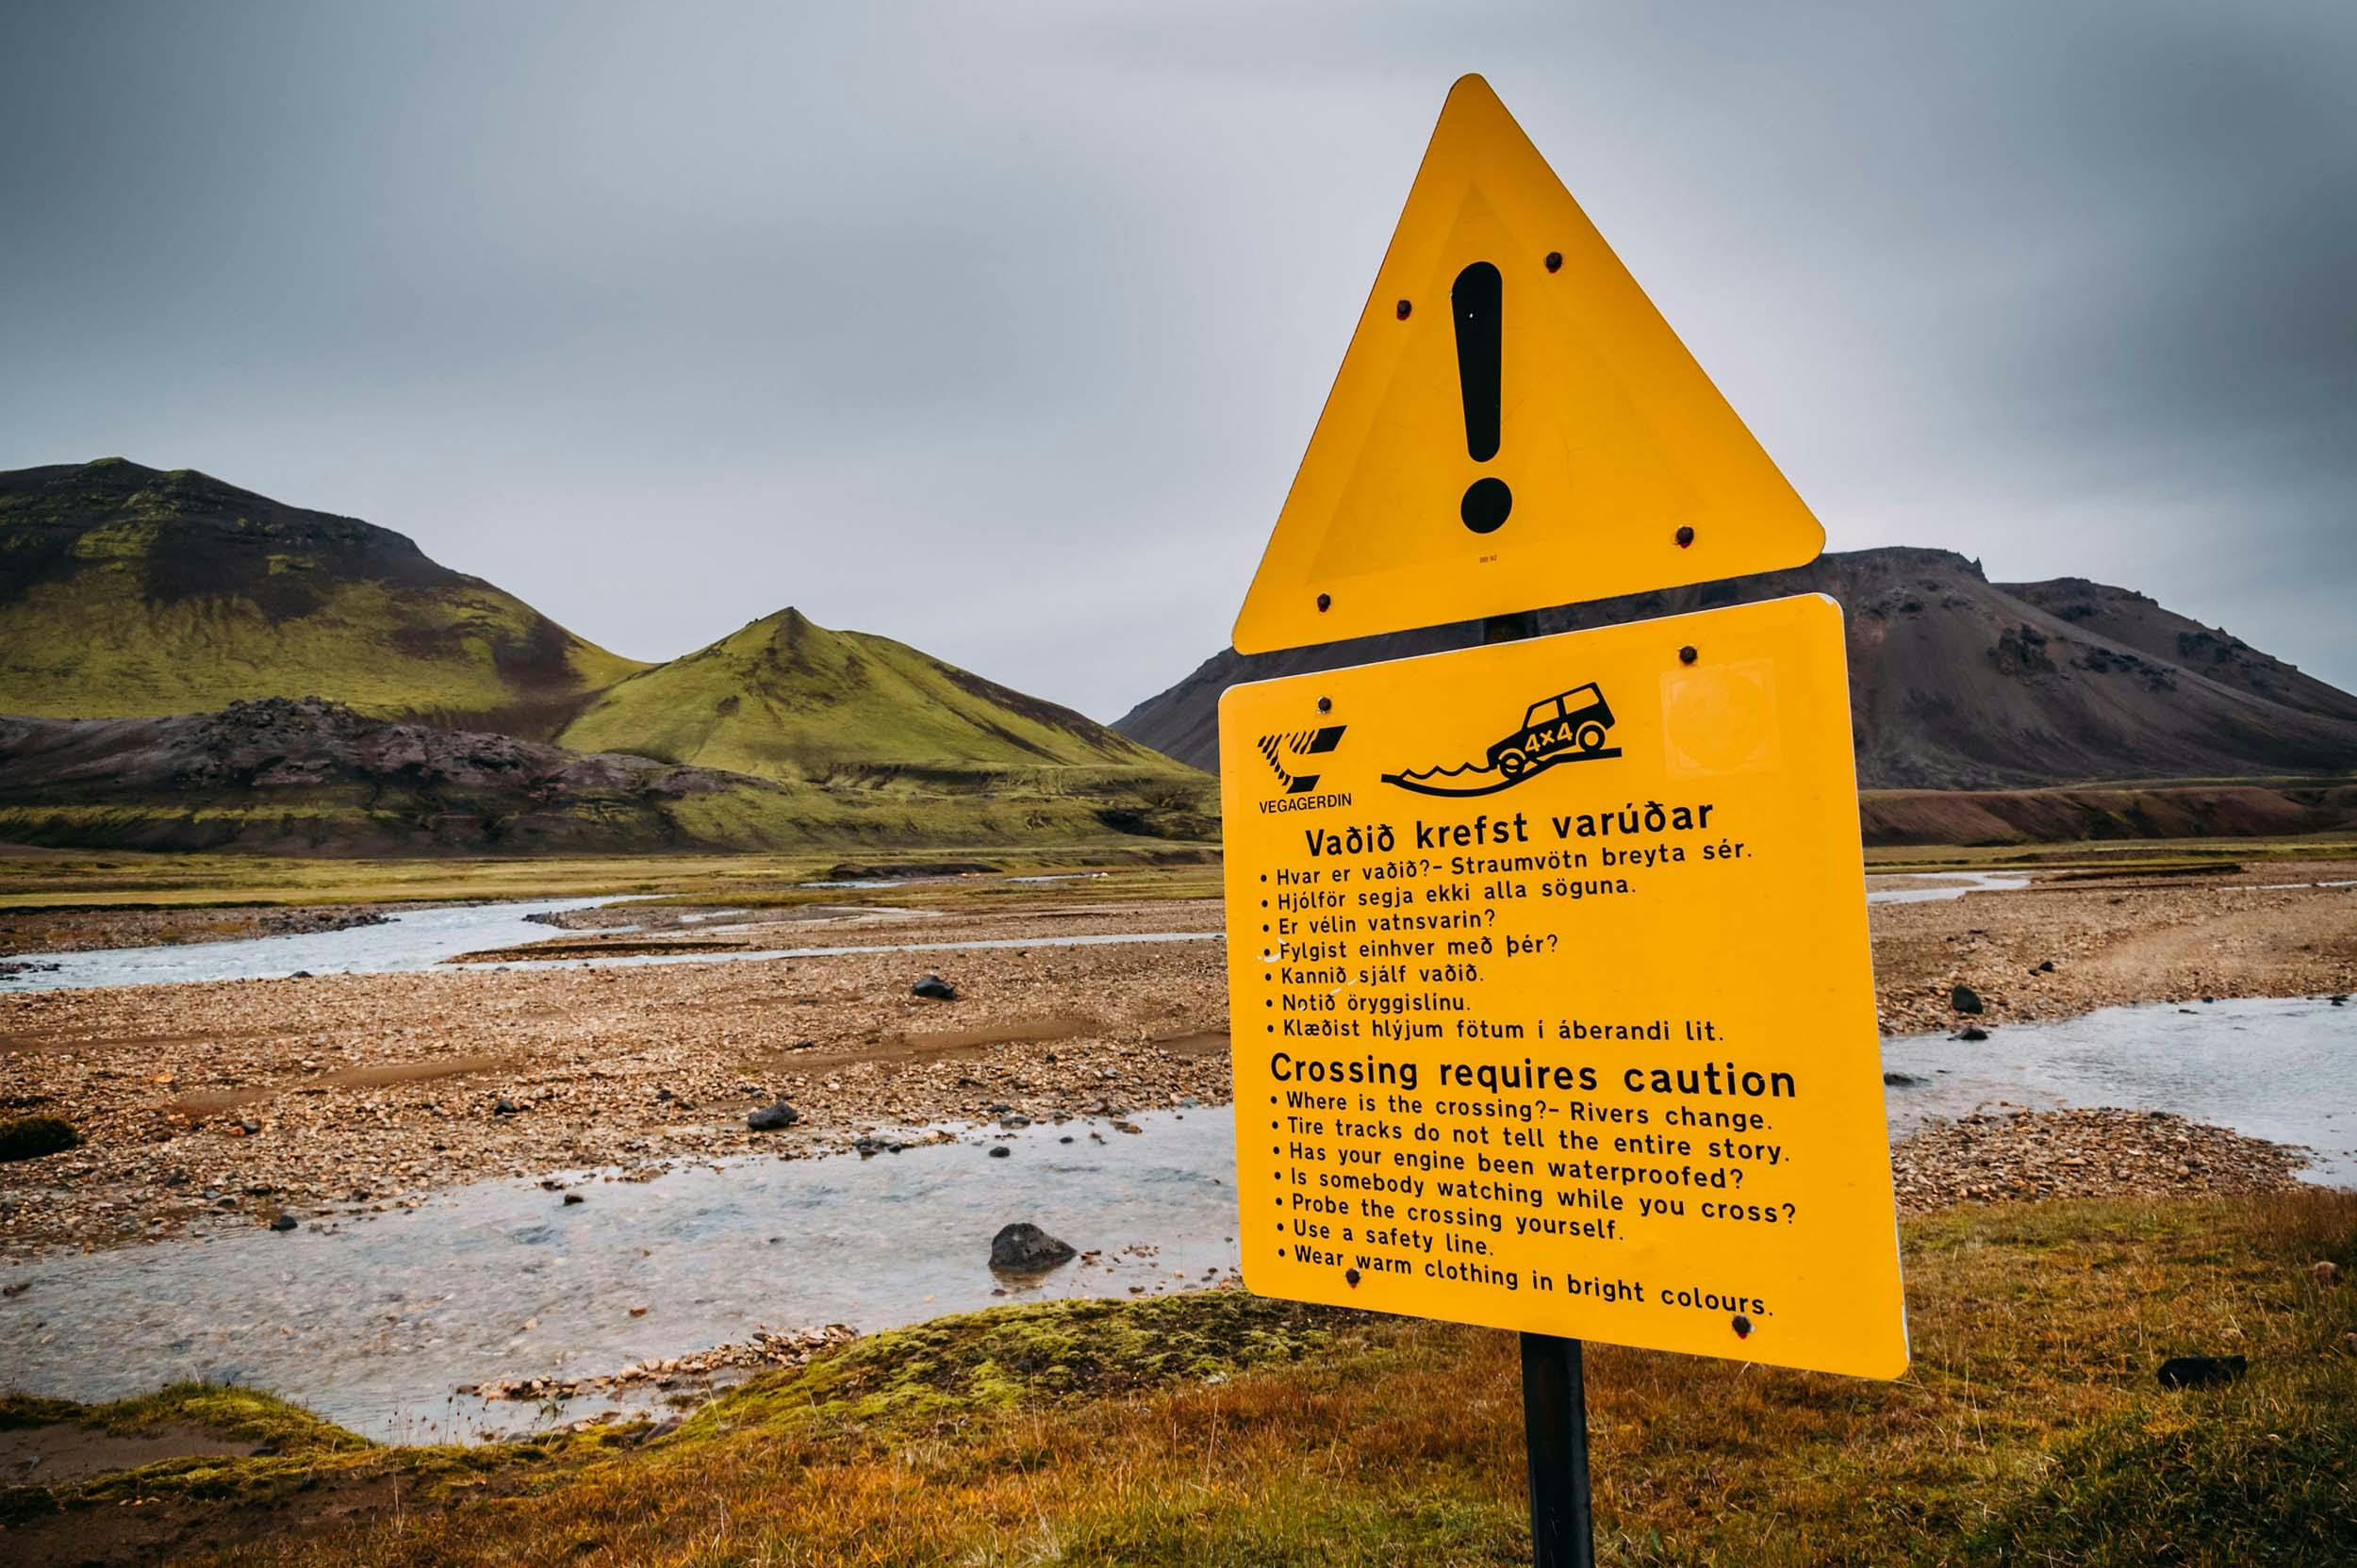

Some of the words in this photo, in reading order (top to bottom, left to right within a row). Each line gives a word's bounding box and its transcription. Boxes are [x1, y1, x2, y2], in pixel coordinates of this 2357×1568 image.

[1525, 721, 1574, 752] 4x4
[1305, 823, 1395, 857] Vaðið
[1416, 812, 1529, 850] krefst
[1551, 801, 1714, 839] varúðar
[1277, 868, 1321, 886] Hvar
[1331, 868, 1351, 883] er
[1451, 850, 1588, 875] Straumvötn
[1602, 843, 1686, 868] breyta
[1703, 838, 1752, 861] sér.
[1277, 890, 1346, 914] Hjólför
[1358, 886, 1413, 909] segja
[1426, 883, 1470, 902] ekki
[1484, 880, 1527, 900] alla
[1541, 879, 1636, 900] söguna.
[1278, 917, 1298, 935] Er
[1309, 916, 1357, 933] vélin
[1367, 908, 1495, 932] vatnsvarin?
[1279, 940, 1347, 963] Fylgist
[1359, 938, 1435, 958] einhver
[1447, 935, 1493, 955] með
[1506, 933, 1558, 958] þér?
[1281, 966, 1347, 984] Kannið
[1360, 965, 1407, 987] sjálf
[1419, 963, 1486, 982] vaðið.
[1282, 993, 1336, 1012] Notið
[1347, 992, 1472, 1015] öryggislínu.
[1283, 1018, 1360, 1037] Klæðist
[1372, 1018, 1443, 1042] hlýjum
[1456, 1019, 1525, 1039] fötum
[1558, 1019, 1670, 1041] áberandi
[1686, 1020, 1723, 1042] lit.
[1270, 1051, 1418, 1091] Crossing
[1440, 1057, 1598, 1095] requires
[1624, 1062, 1796, 1098] caution
[1286, 1090, 1347, 1111] Where
[1359, 1093, 1376, 1112] is
[1387, 1095, 1423, 1114] the
[1570, 1100, 1649, 1125] Rivers
[1665, 1105, 1773, 1133] change.
[1287, 1115, 1324, 1135] Tire
[1335, 1118, 1402, 1140] tracks
[1414, 1122, 1440, 1142] do
[1453, 1126, 1490, 1145] not
[1502, 1127, 1545, 1147] tell
[1558, 1130, 1599, 1151] the
[1613, 1133, 1691, 1156] entire
[1708, 1138, 1789, 1165] story.
[1290, 1141, 1327, 1162] Has
[1338, 1148, 1382, 1166] your
[1393, 1149, 1465, 1172] engine
[1477, 1152, 1534, 1176] been
[1547, 1160, 1743, 1190] waterproofed?
[1291, 1166, 1307, 1185] Is
[1319, 1172, 1425, 1198] somebody
[1437, 1180, 1542, 1208] watching
[1557, 1187, 1624, 1211] while
[1639, 1197, 1685, 1217] you
[1701, 1202, 1796, 1225] cross?
[1293, 1192, 1349, 1215] Probe
[1360, 1198, 1395, 1219] the
[1407, 1207, 1502, 1232] crossing
[1515, 1216, 1624, 1241] yourself.
[1294, 1218, 1330, 1239] Use
[1343, 1228, 1354, 1242] a
[1365, 1227, 1433, 1253] safety
[1445, 1232, 1493, 1256] line.
[1294, 1244, 1343, 1266] Wear
[1355, 1255, 1412, 1275] warm
[1425, 1259, 1518, 1291] clothing
[1532, 1269, 1553, 1292] in
[1567, 1273, 1645, 1303] bright
[1660, 1287, 1773, 1316] colours.
